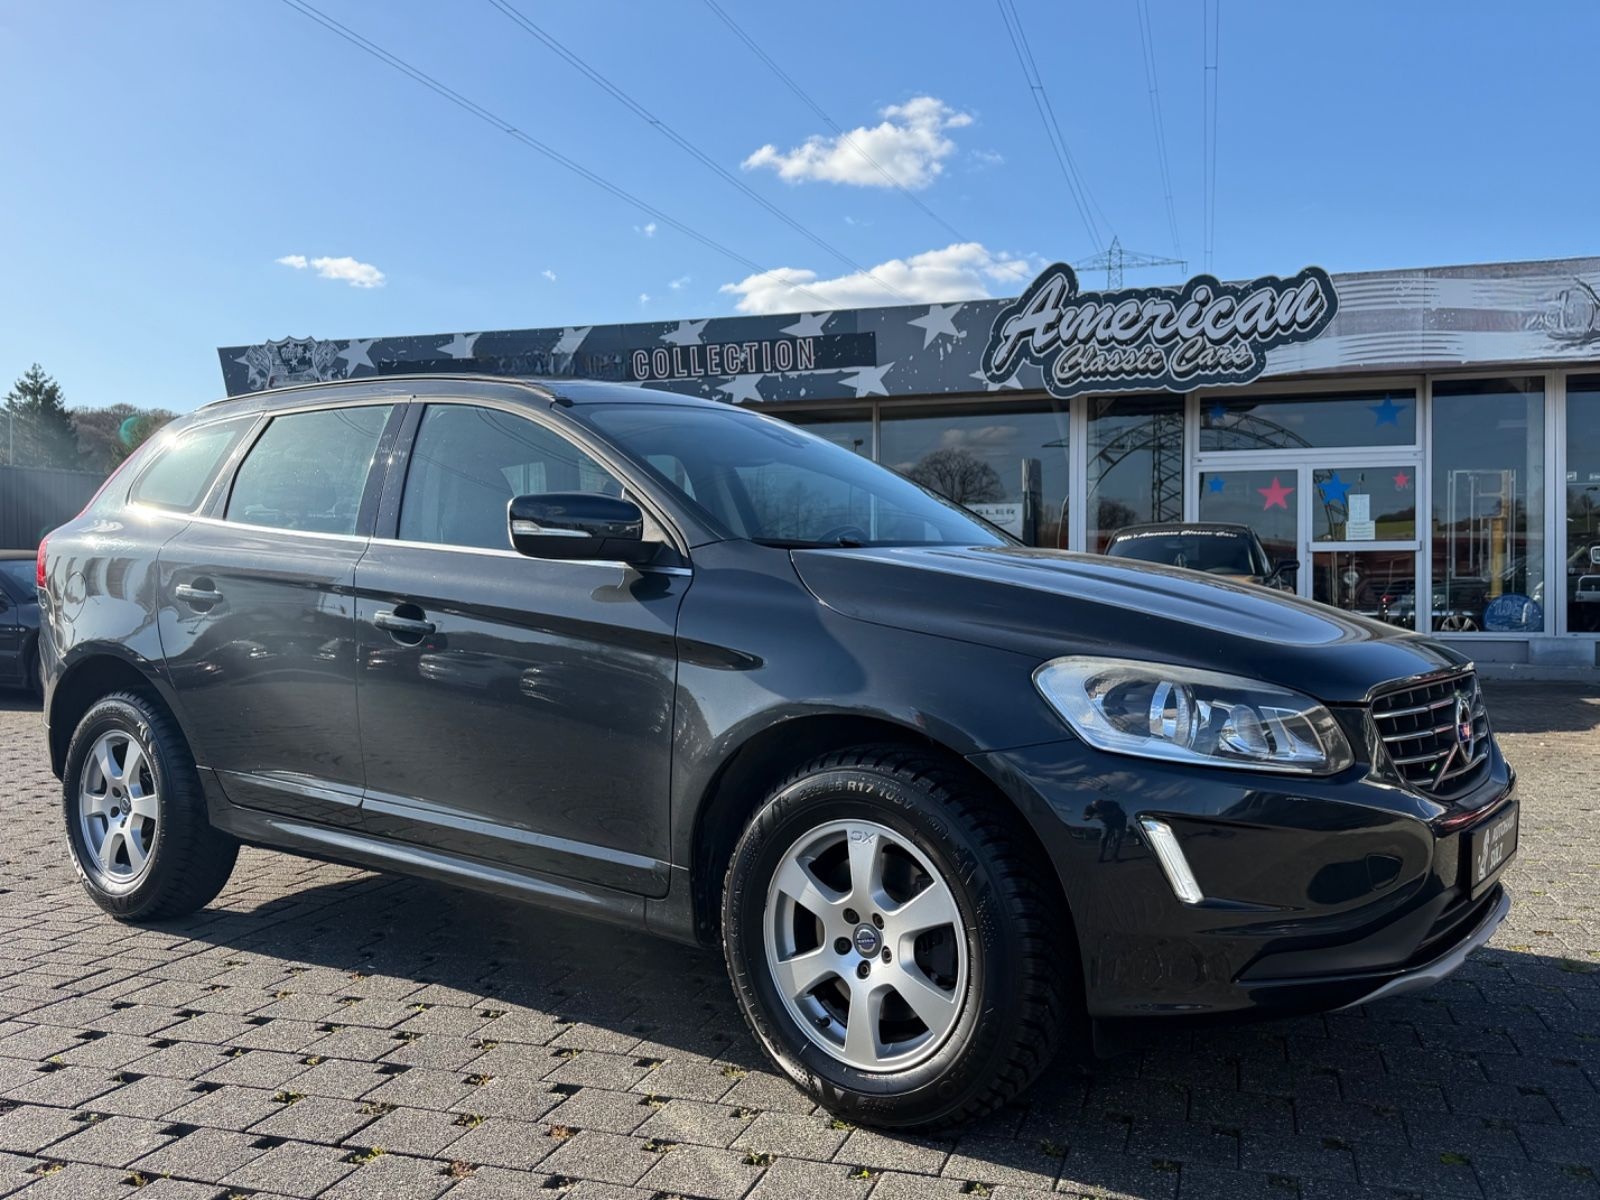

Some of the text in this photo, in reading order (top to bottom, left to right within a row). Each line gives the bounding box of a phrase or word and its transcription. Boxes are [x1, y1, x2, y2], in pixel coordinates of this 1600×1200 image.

[993, 274, 1326, 373] American
[632, 338, 815, 380] COLLECTION
[1055, 337, 1254, 382] Classic Cars
[847, 780, 875, 793] R17
